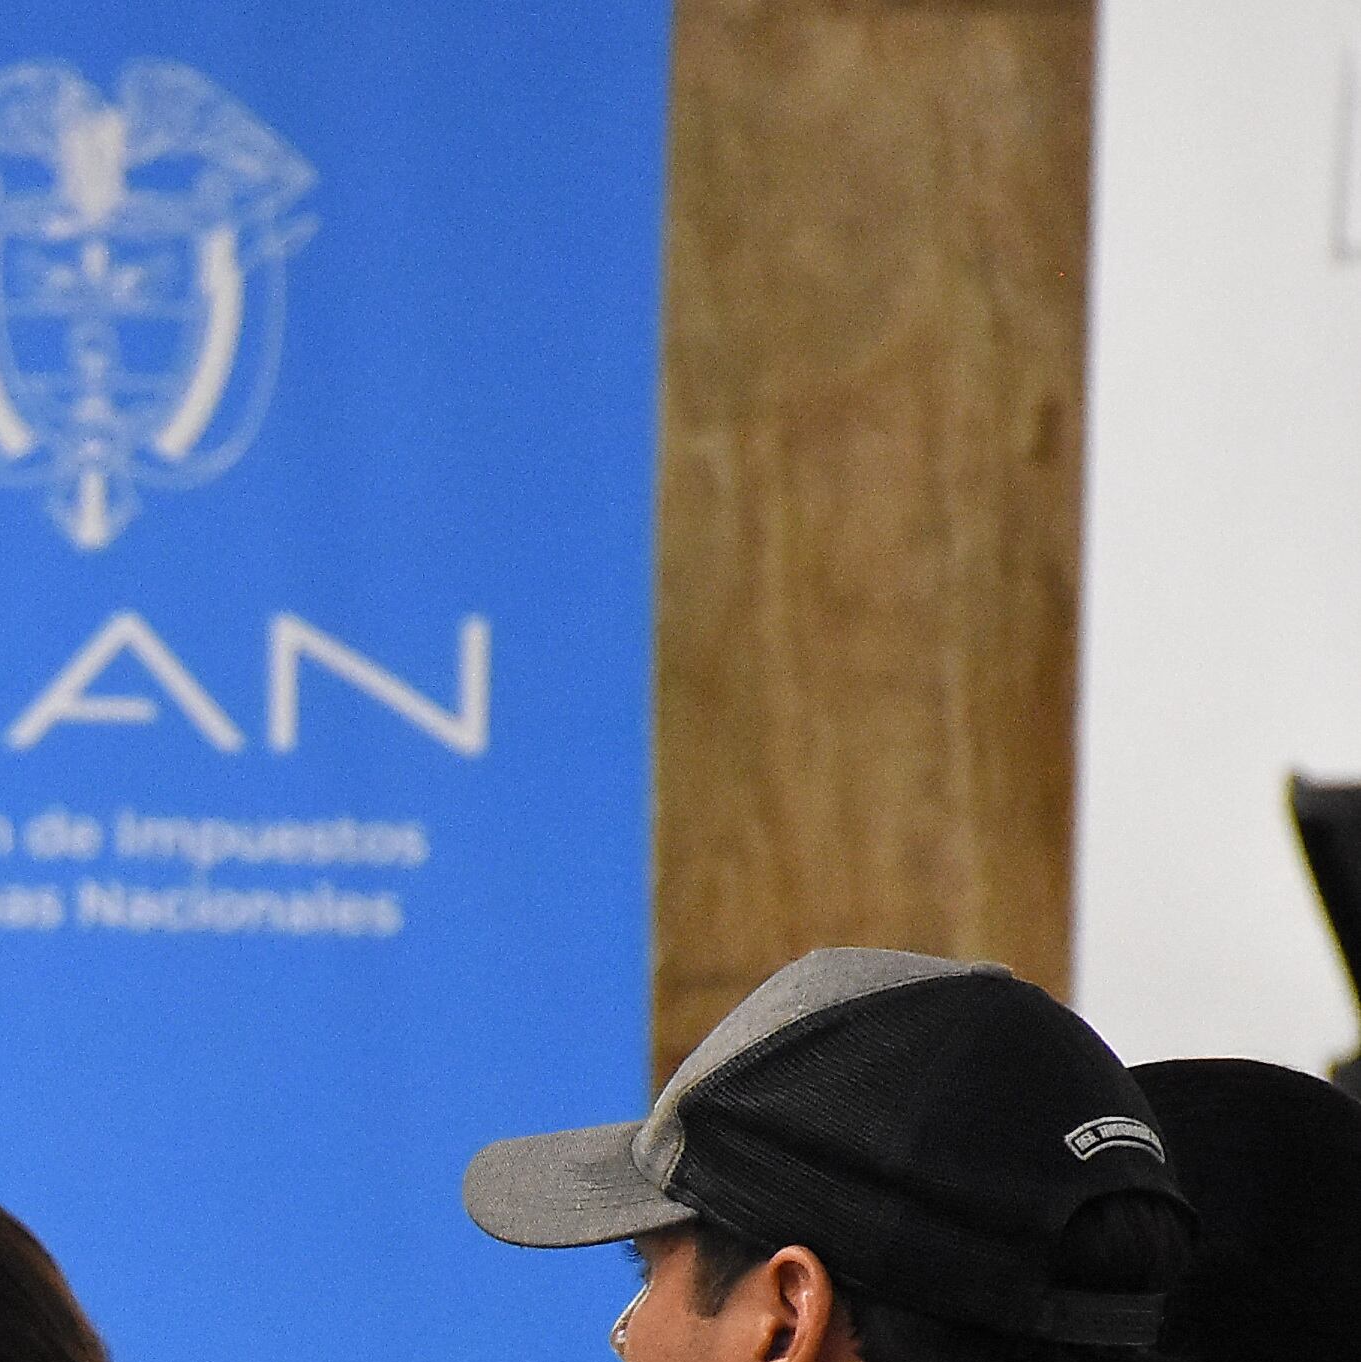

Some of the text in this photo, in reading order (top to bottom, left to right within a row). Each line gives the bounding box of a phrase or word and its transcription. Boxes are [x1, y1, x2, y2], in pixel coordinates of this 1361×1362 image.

[23, 803, 103, 862] de
[114, 806, 430, 872] Impuestos
[75, 879, 404, 936] Nacionales
